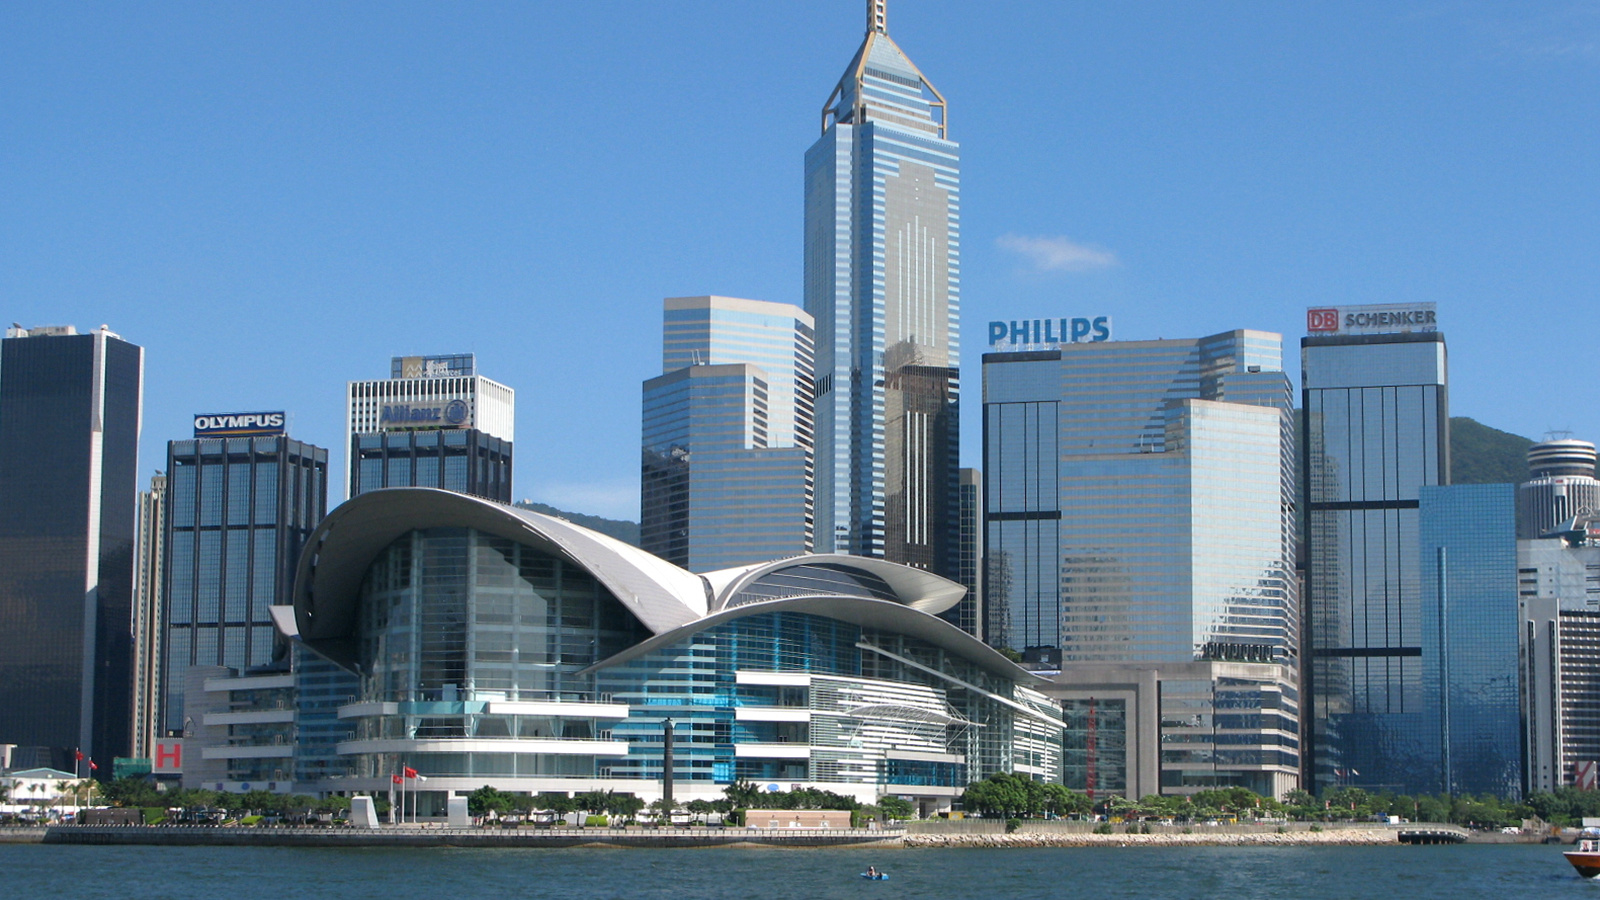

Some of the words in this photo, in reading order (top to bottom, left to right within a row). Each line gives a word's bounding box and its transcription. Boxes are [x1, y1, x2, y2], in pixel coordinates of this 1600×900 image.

[1310, 312, 1336, 329] DB
[1345, 311, 1436, 327] SCHENKER
[989, 317, 1109, 345] PHILIPS
[195, 414, 283, 430] OLYMPUS
[380, 405, 441, 423] Allianz
[157, 744, 181, 768] H
